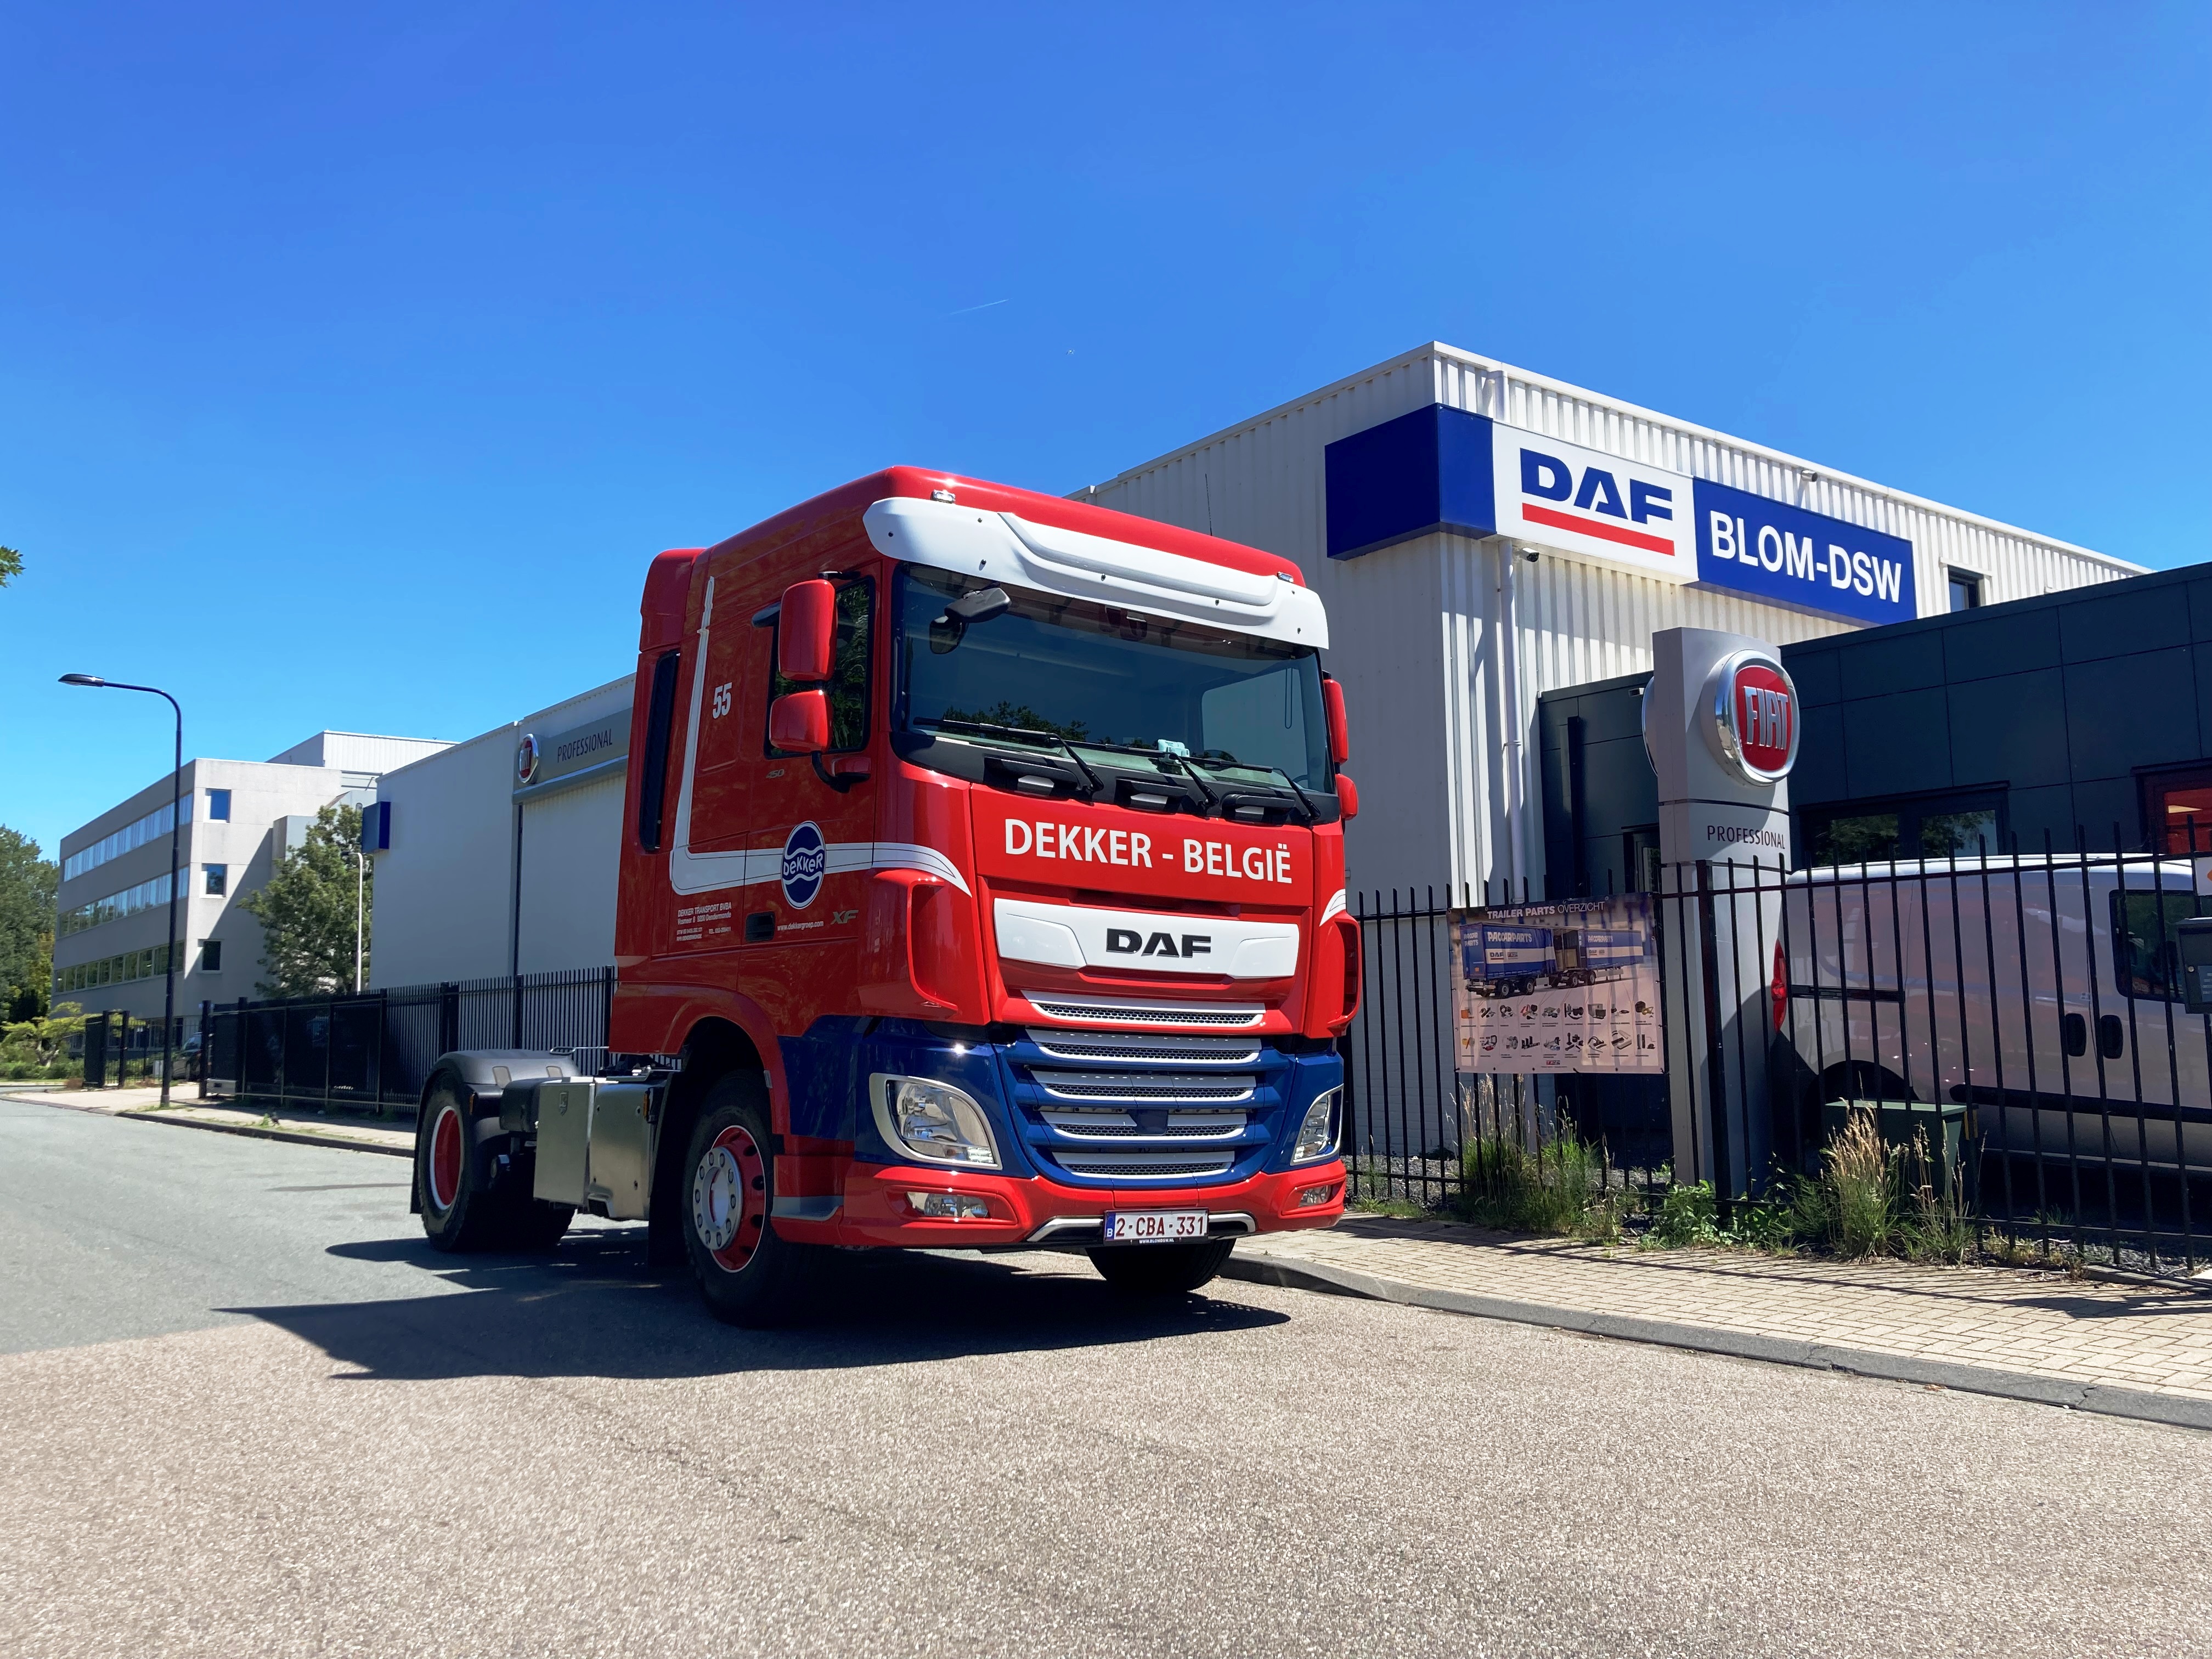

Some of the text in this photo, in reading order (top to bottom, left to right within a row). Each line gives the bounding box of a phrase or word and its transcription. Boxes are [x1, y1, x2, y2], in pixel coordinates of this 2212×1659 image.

[1520, 448, 1672, 524] DAF
[1711, 511, 1901, 603] BLOM-DSW
[713, 682, 732, 719] 55
[1743, 686, 1788, 750] FIAT
[557, 729, 613, 763] PROFESSIONAL
[1005, 819, 1153, 868] DEKKER
[1184, 839, 1292, 884] BELGIË
[1707, 825, 1785, 849] PROFESSIONAL
[678, 908, 694, 917] DEKKER
[695, 904, 720, 915] TRANSPORT
[830, 910, 859, 925] XF
[1487, 901, 1605, 919] TRAILER PARTS OVERZICHT
[1105, 928, 1211, 958] DAF
[1107, 1228, 1113, 1237] B
